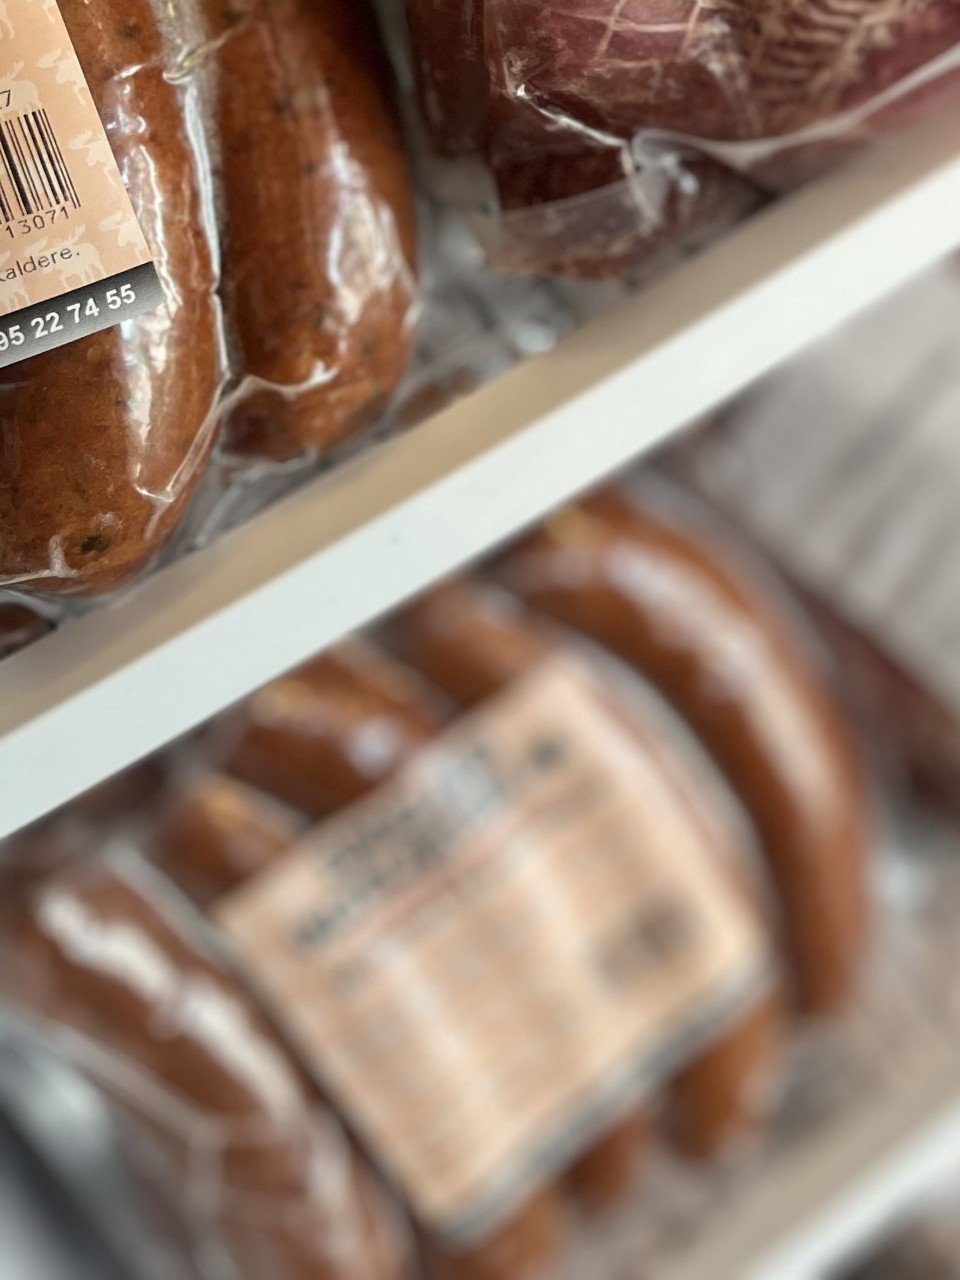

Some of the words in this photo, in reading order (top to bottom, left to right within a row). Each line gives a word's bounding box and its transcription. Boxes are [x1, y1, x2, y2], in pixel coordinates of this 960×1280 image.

[30, 311, 64, 339] 22
[66, 297, 101, 324] 74
[105, 282, 137, 310] 55
